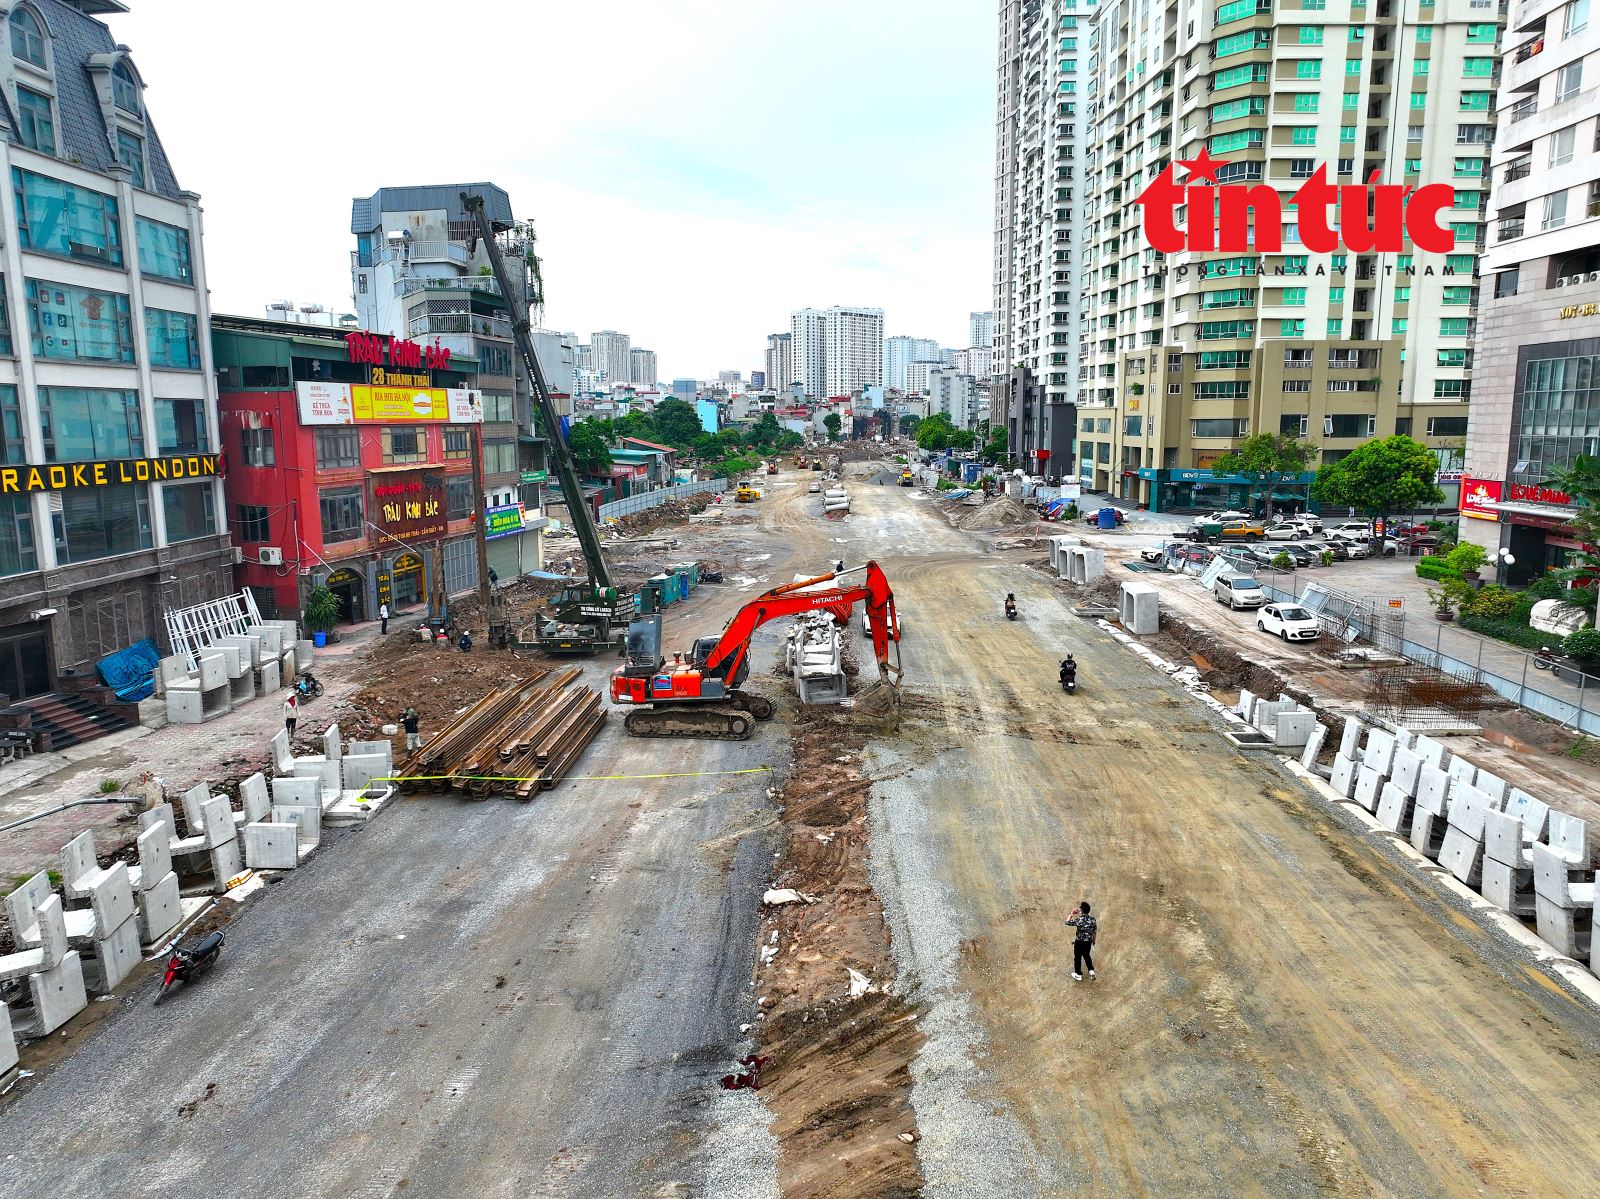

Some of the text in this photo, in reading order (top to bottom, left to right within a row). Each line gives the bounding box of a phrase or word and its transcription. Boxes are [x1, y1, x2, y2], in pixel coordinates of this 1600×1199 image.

[344, 330, 451, 369] TRÂU KINH BẮC
[372, 367, 385, 384] 28
[1, 456, 215, 493] RAOKE LONDON
[383, 501, 401, 523] TRÂU
[405, 501, 422, 520] KINH
[812, 594, 843, 605] HITACHI
